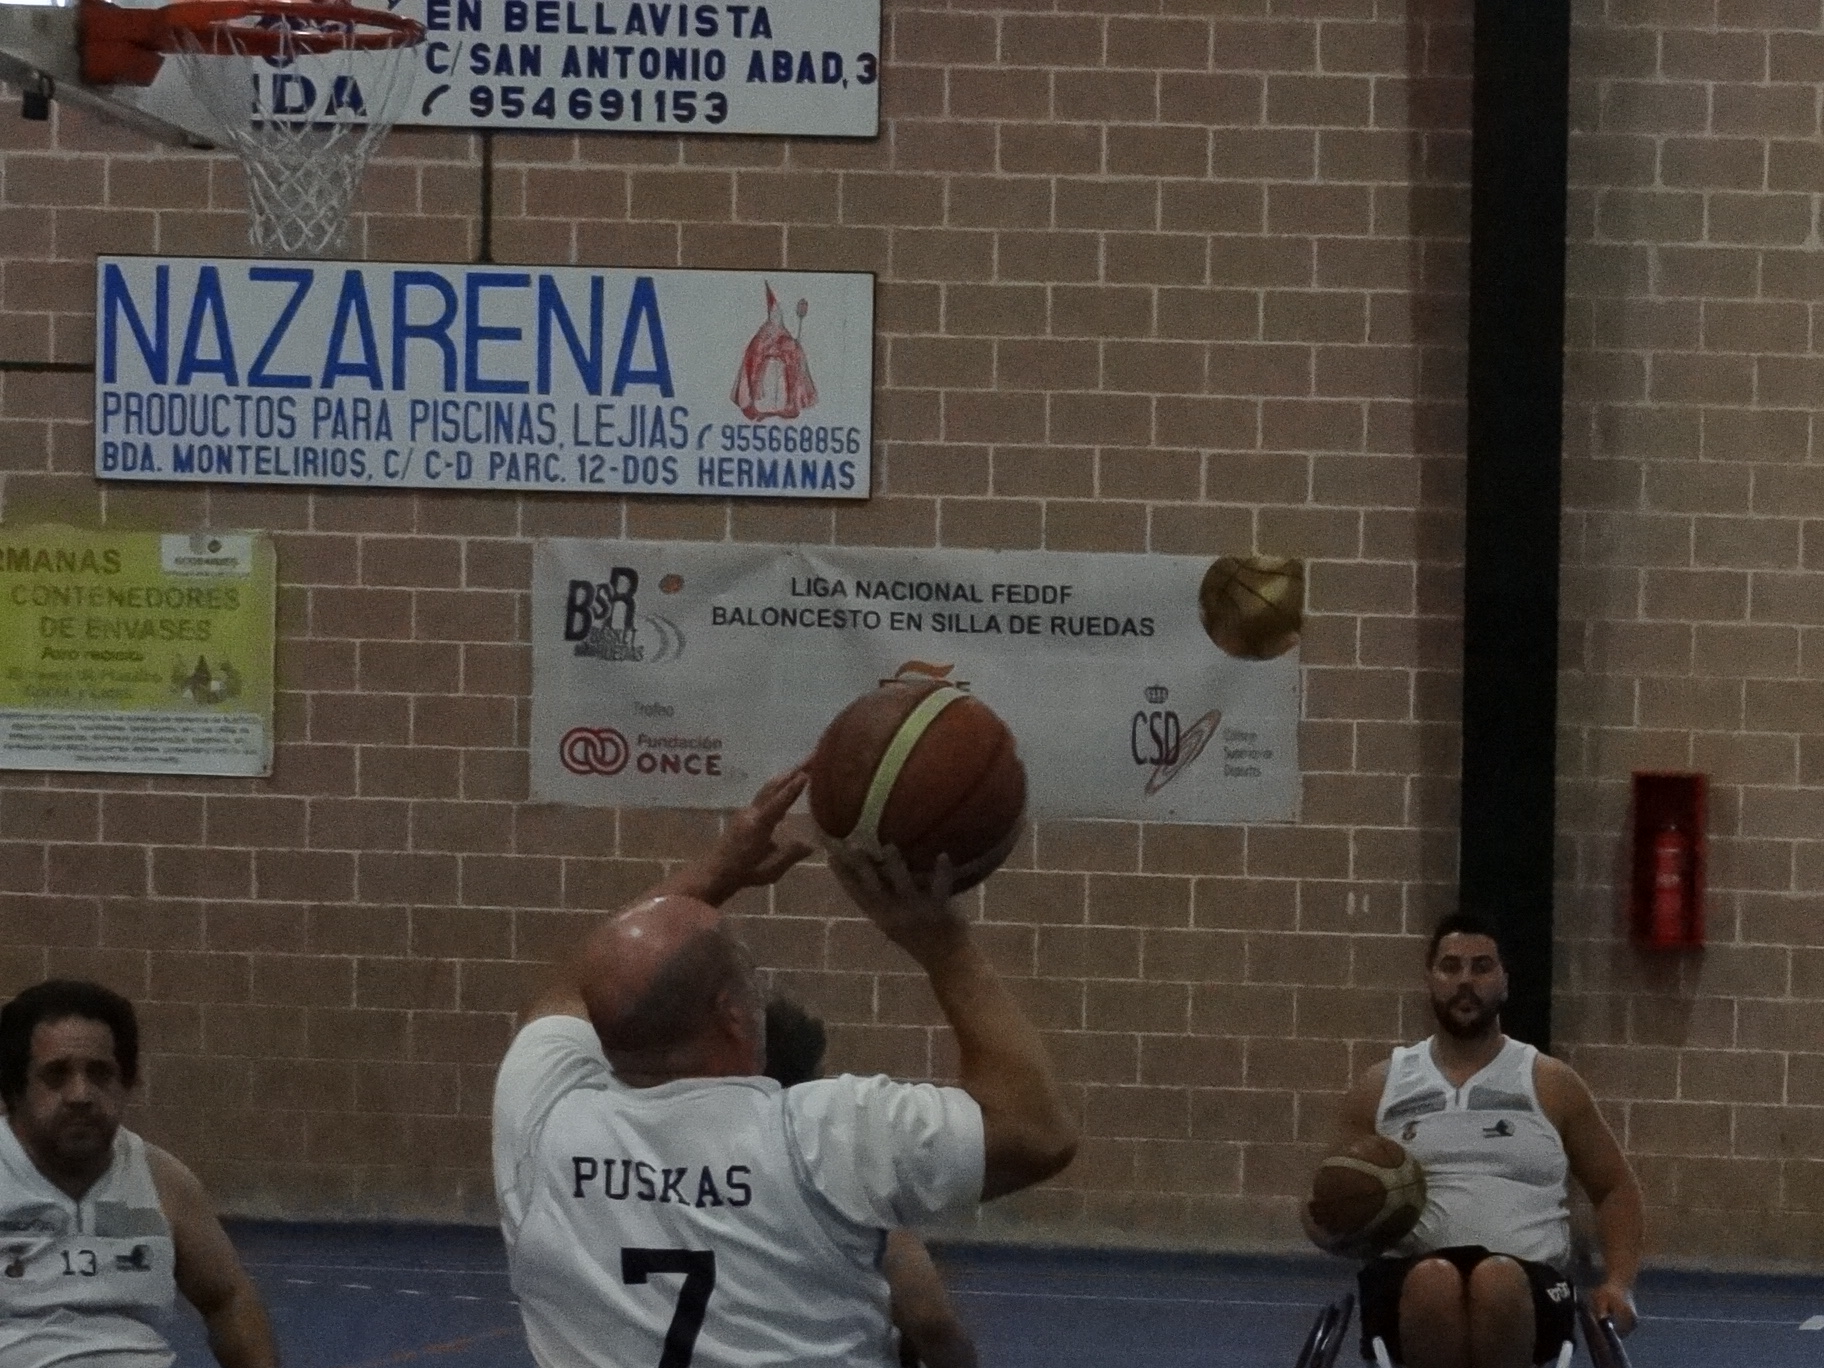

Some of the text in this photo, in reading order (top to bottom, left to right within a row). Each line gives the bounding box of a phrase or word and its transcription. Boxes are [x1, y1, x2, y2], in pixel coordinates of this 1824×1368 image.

[426, 0, 773, 39] EN BELLAVISTA
[470, 43, 542, 77] SAN
[561, 45, 727, 82] ANTONIO
[469, 86, 728, 124] 954691153
[102, 264, 675, 399] NAZARENA
[102, 391, 690, 450] PRODUCTOS PARA PISCINAS, LEJIAS
[720, 423, 861, 454] 955668856
[102, 441, 162, 473] BDA.
[172, 443, 373, 481] MONTELIRIOS,
[489, 451, 567, 483] PARC.
[698, 457, 857, 491] HERMANAS
[0, 546, 122, 575] MANAS
[10, 583, 241, 612] CONTENEDORES
[790, 576, 1074, 604] LIGA NACIONAL FEDDF
[39, 615, 213, 642] DE ENVASES
[711, 606, 1156, 638] BALONCESTO EN SILLA DE RUEDAS
[1131, 710, 1181, 767] CSD
[636, 752, 723, 777] ONCE
[571, 1155, 753, 1208] PUSKAS
